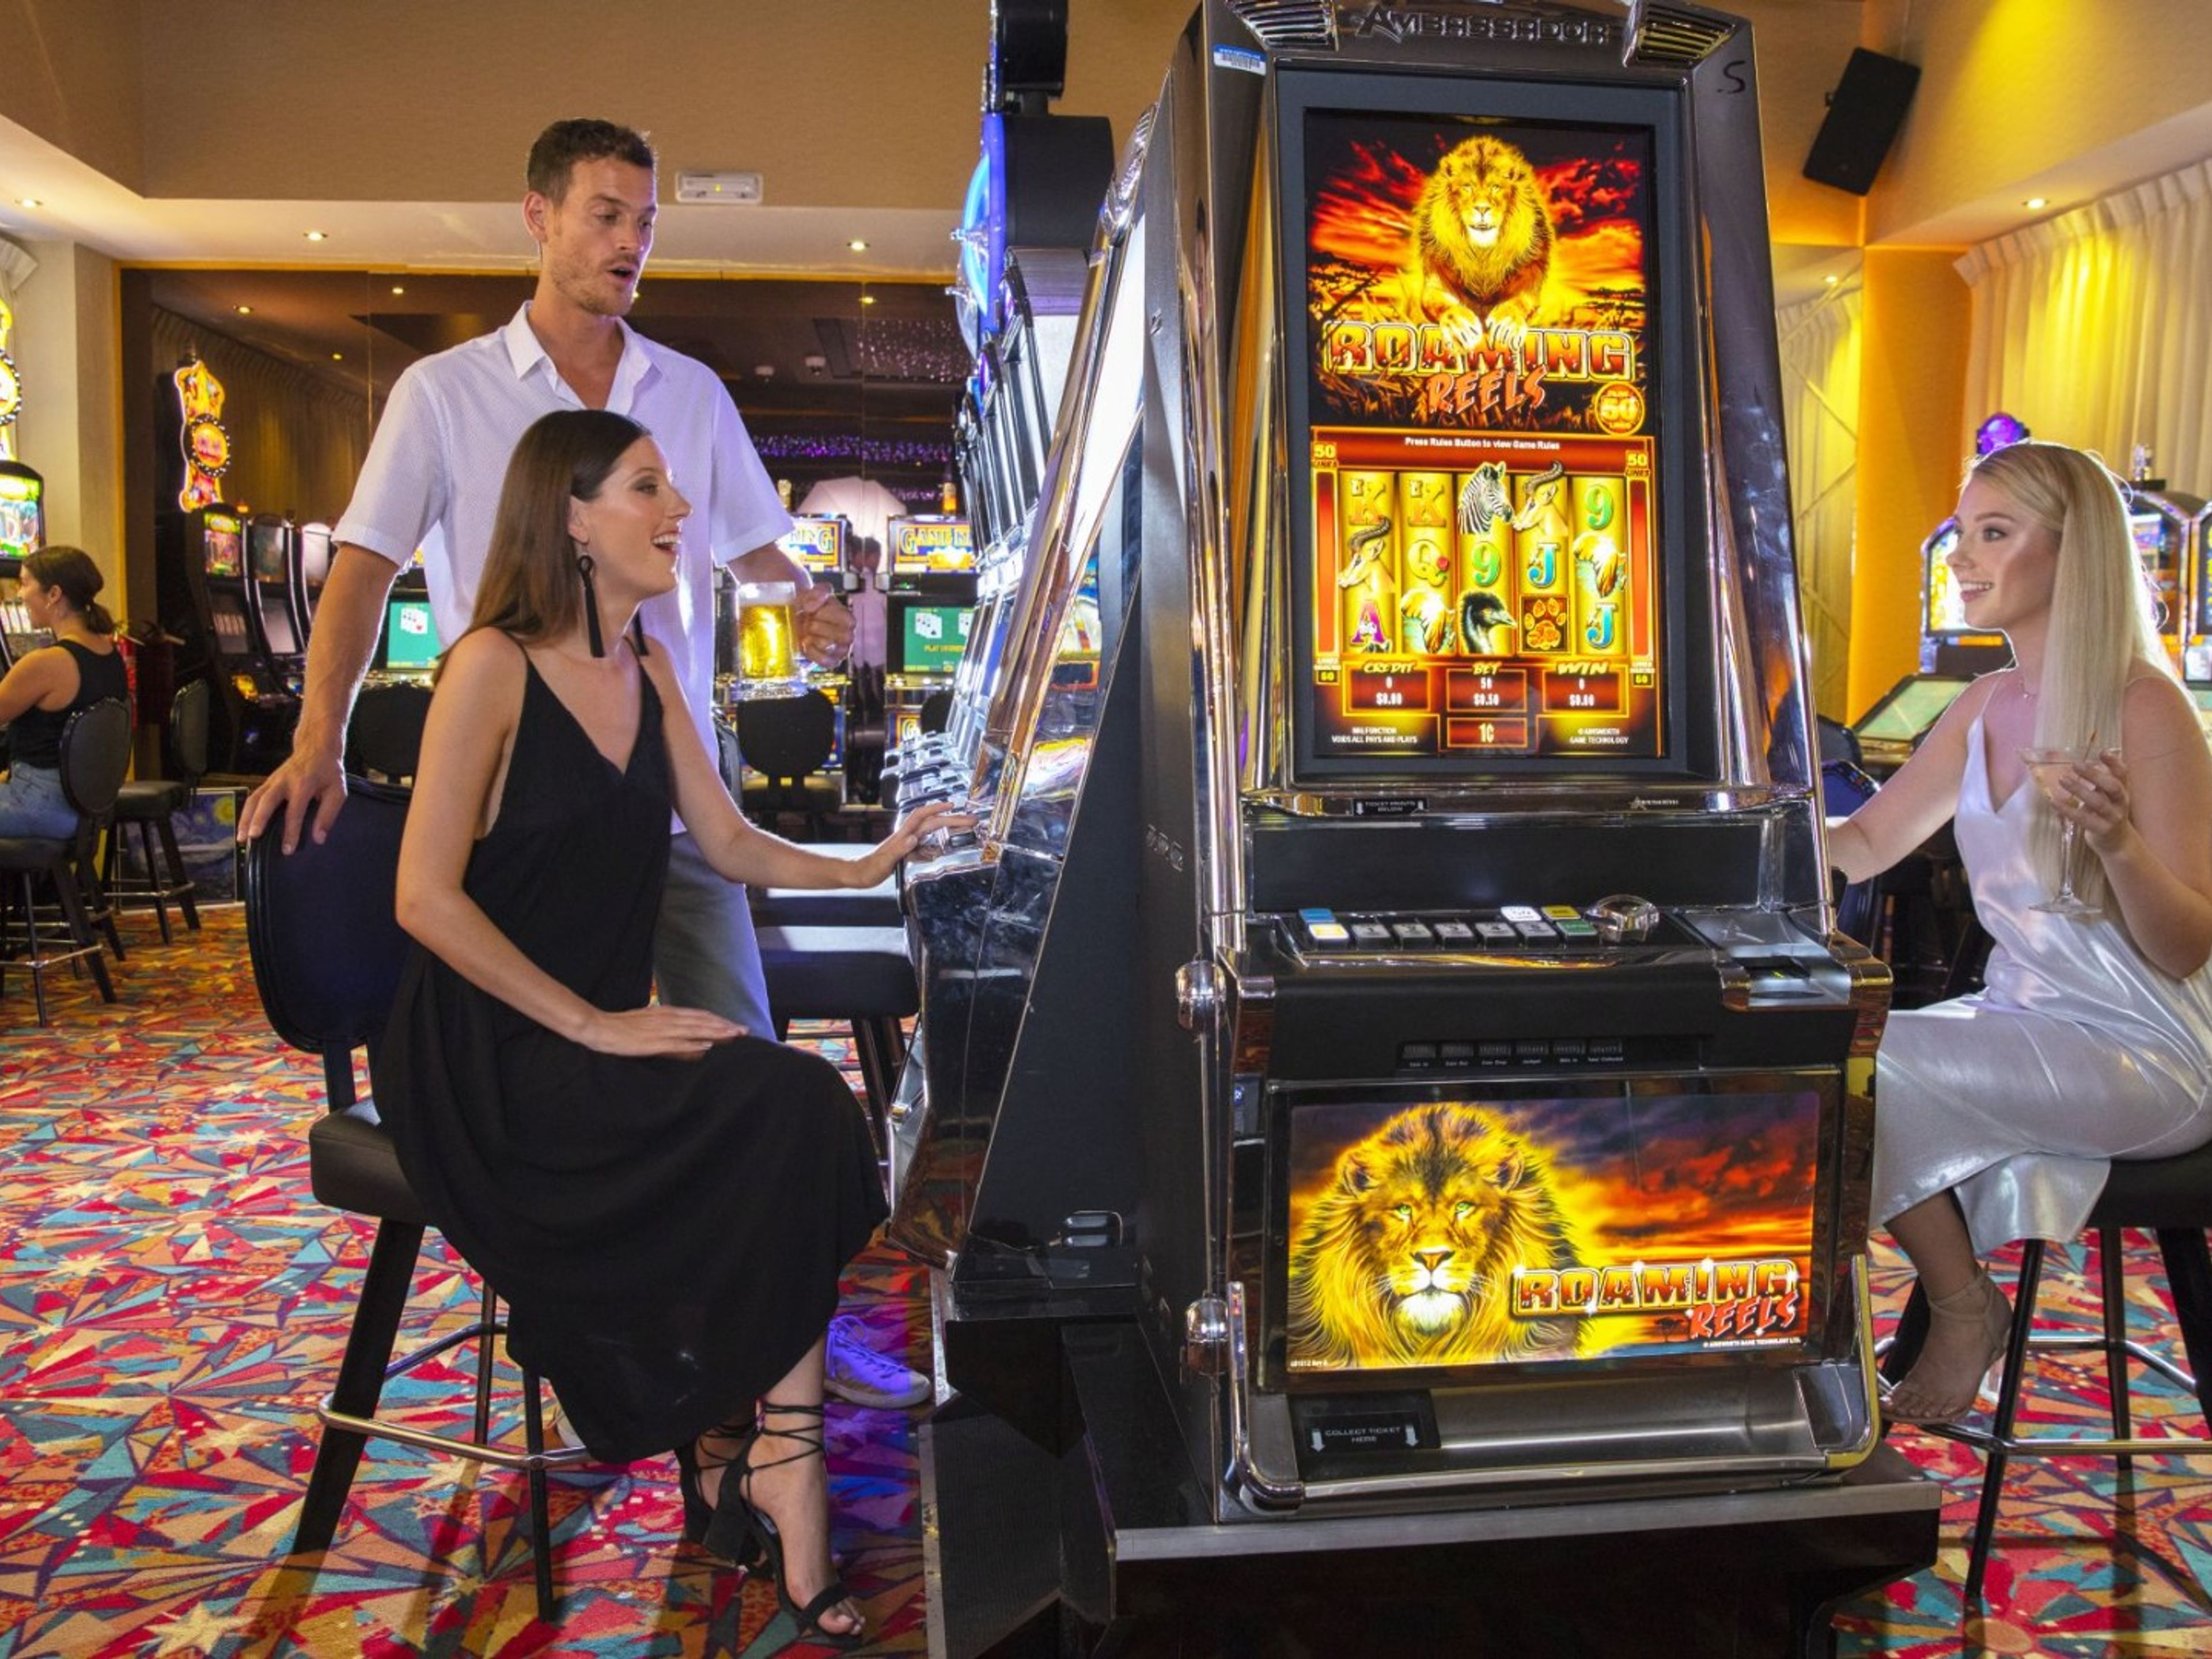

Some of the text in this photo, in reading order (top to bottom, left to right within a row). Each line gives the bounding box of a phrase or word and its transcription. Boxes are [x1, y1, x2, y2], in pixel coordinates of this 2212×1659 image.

[1355, 3, 1611, 44] AMBASSADOR
[1326, 322, 1632, 378] ROAMING
[1427, 365, 1547, 414] REELS
[1601, 396, 1638, 420] 50
[1314, 444, 1336, 459] 50
[1405, 437, 1560, 450] Press Rules Button to view Game Rules
[1627, 453, 1647, 466] 50
[1586, 484, 1615, 530] 9
[1407, 539, 1447, 587] Q
[1472, 541, 1501, 587] 9
[1528, 543, 1560, 588] J
[1351, 600, 1385, 644] A
[1587, 602, 1616, 649] J
[1363, 662, 1415, 674] CREDIT
[1472, 662, 1503, 675] BET
[1480, 676, 1493, 690] 50
[1557, 661, 1609, 675] WIN
[1351, 735, 1364, 743] ALL
[1515, 1260, 1793, 1312] ROAMING
[1690, 1289, 1798, 1339] REELS
[1325, 1426, 1401, 1437] COLLECT TICKET
